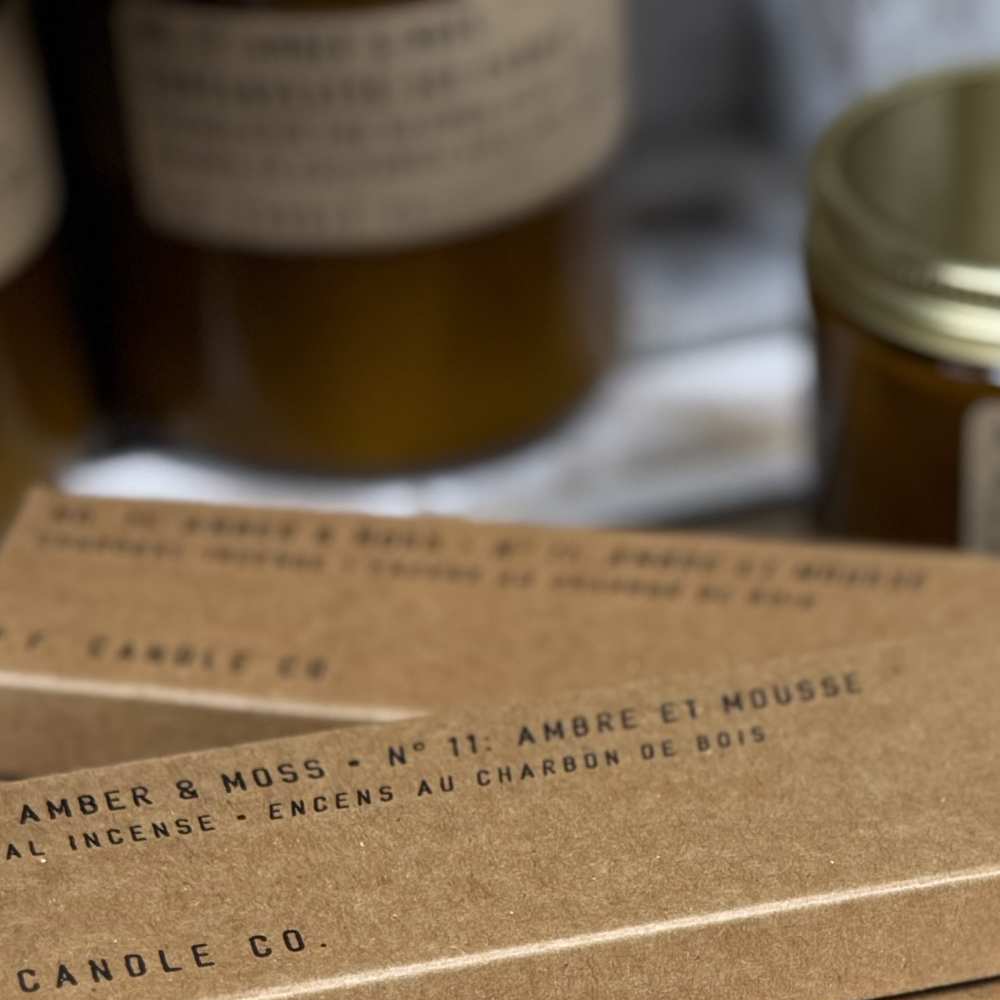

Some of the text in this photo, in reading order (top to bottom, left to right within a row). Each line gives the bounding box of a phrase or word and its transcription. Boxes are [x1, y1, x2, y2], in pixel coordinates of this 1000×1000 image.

[19, 785, 152, 824] AMBER
[176, 779, 198, 800] &
[221, 759, 324, 793] MOSS
[448, 733, 491, 757] 11:
[518, 709, 636, 746] AMBRE
[659, 697, 699, 724] ET
[721, 673, 861, 715] MOUSSE
[68, 815, 216, 850] INCENSE
[269, 786, 393, 820] ENCENS
[418, 776, 454, 796] AU
[476, 750, 619, 786] CHARBON
[640, 740, 676, 760] DE
[696, 726, 767, 752] BOIS
[17, 929, 326, 993] CANDLE CO.
